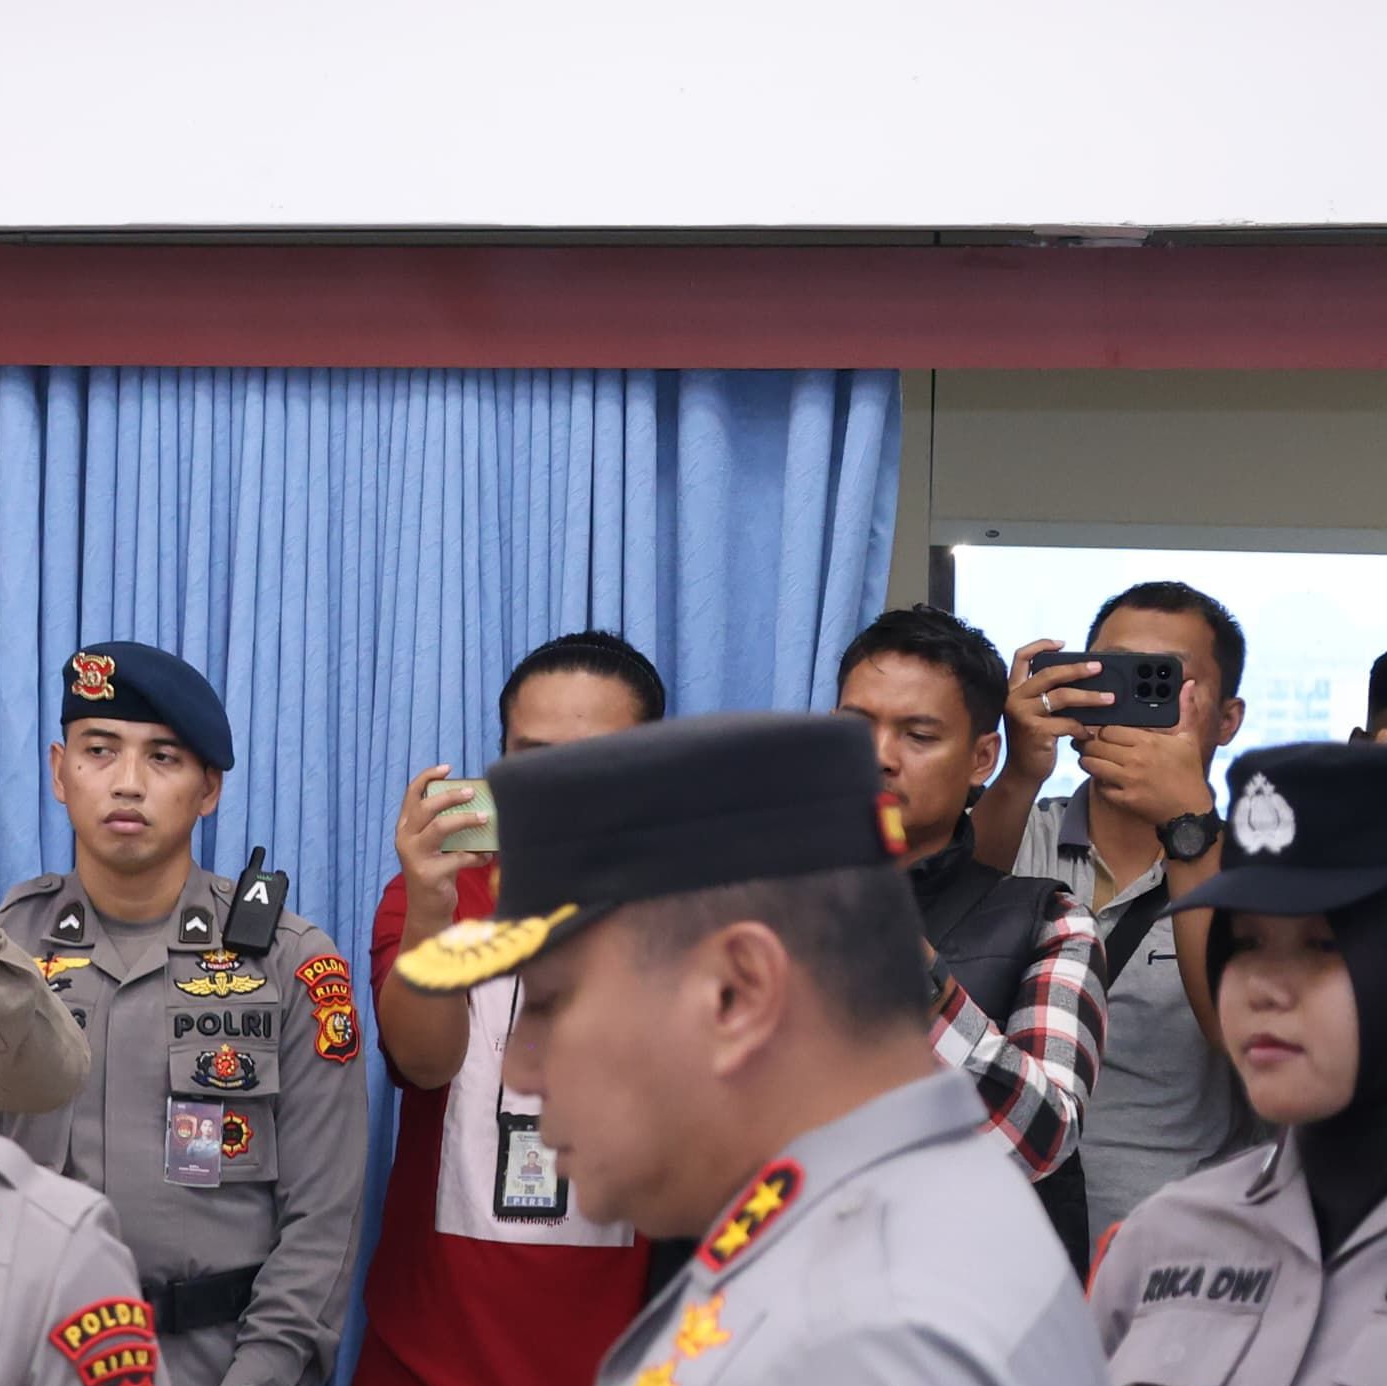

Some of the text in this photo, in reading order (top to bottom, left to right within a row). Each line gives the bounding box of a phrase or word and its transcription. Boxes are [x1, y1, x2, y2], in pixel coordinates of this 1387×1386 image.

[243, 881, 269, 905] A
[304, 958, 346, 981] POLDA
[315, 984, 348, 997] RIAU
[174, 1010, 272, 1039] POLRI
[1207, 1266, 1273, 1303] DWI
[64, 1303, 148, 1349] POLDA
[92, 1349, 149, 1378] RIAU
